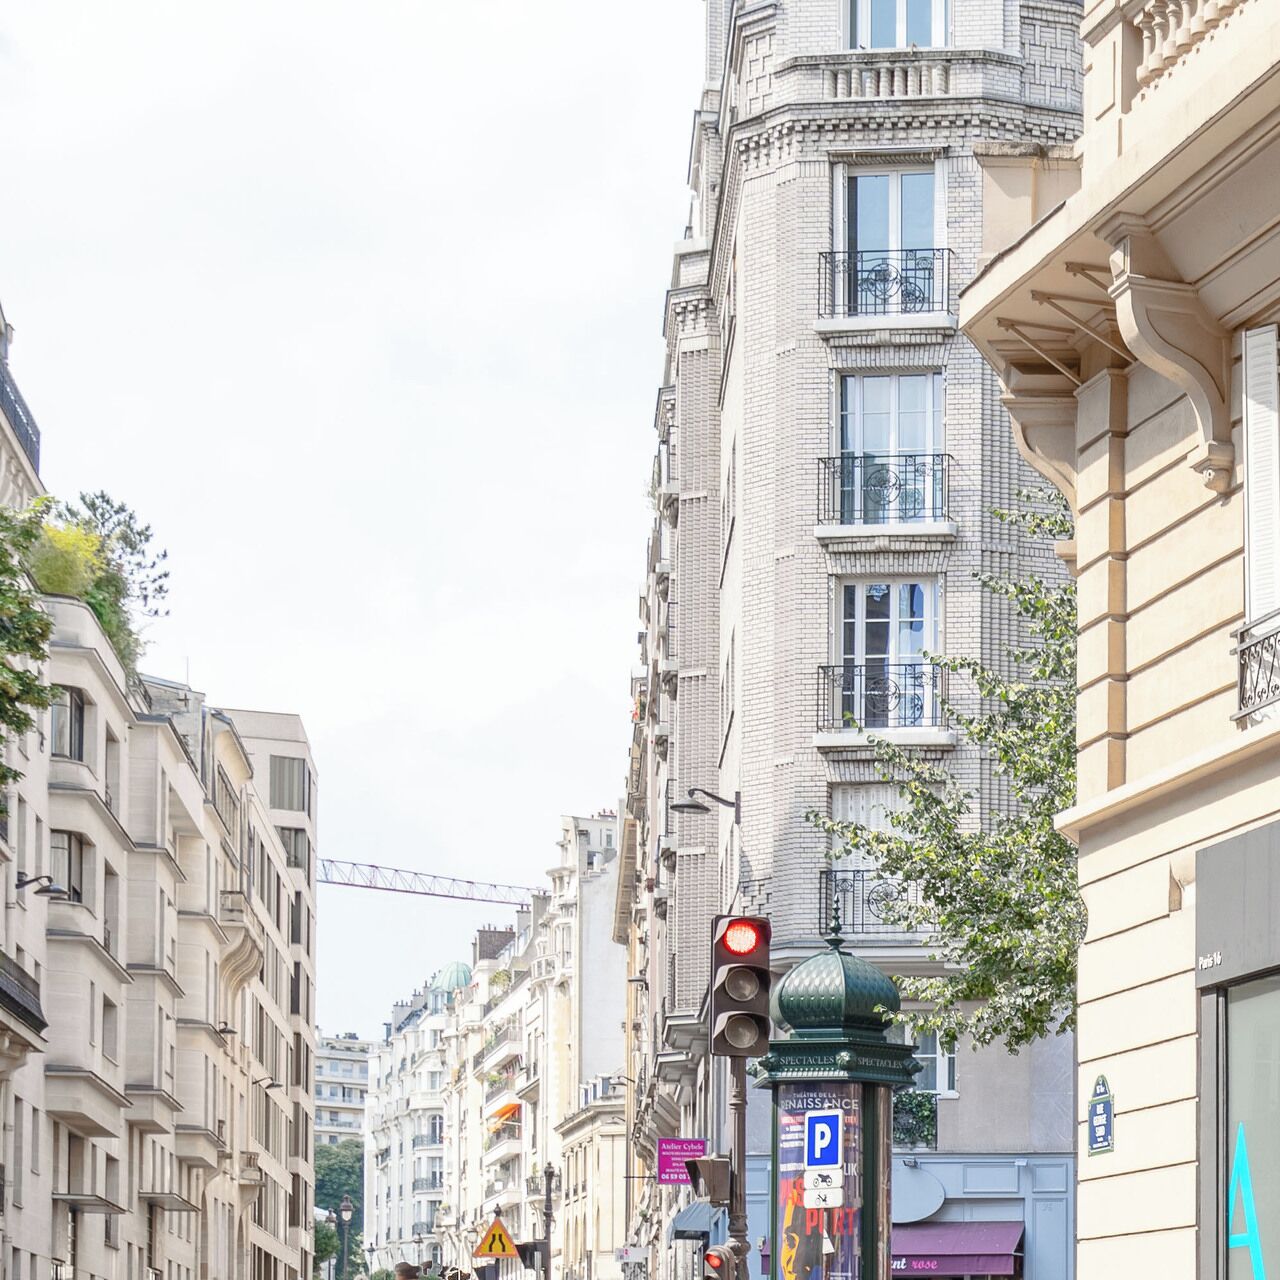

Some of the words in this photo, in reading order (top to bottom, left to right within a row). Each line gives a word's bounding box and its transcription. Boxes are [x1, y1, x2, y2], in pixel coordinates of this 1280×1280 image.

[1199, 954, 1213, 970] Paris
[1213, 951, 1222, 966] 16
[779, 1055, 835, 1065] SPECTACLES
[857, 1056, 902, 1069] SPECTACLES
[814, 1123, 832, 1159] P
[911, 1260, 938, 1269] rose
